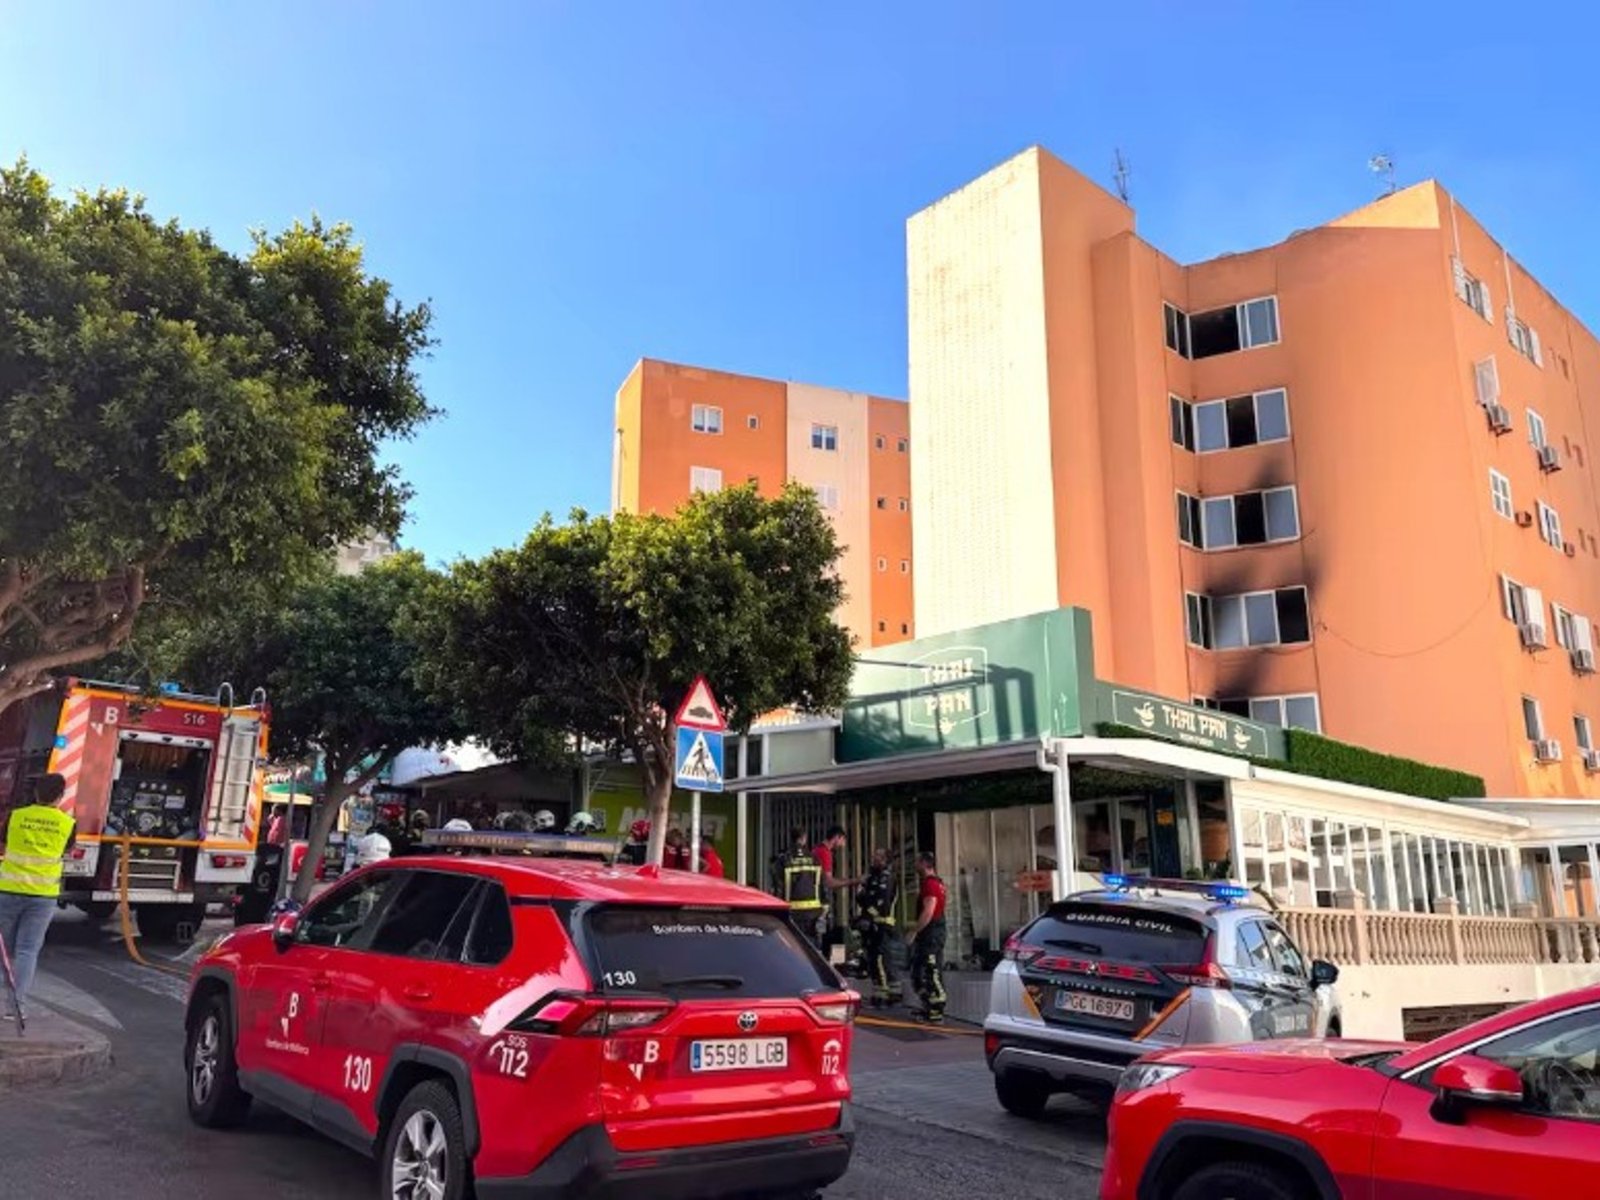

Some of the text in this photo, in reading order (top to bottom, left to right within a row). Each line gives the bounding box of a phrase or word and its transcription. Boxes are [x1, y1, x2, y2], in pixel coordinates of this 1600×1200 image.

[922, 657, 974, 686] THAI
[104, 706, 119, 724] B
[924, 690, 972, 717] PAN
[1161, 704, 1196, 733] THAI
[1197, 714, 1228, 740] PAN
[1066, 912, 1173, 933] GUARDIA CIVIL
[603, 970, 637, 986] 130
[507, 1034, 528, 1048] SOS
[500, 1047, 529, 1078] 112
[704, 1042, 785, 1067] 5598 LGB
[343, 1054, 372, 1093] 130
